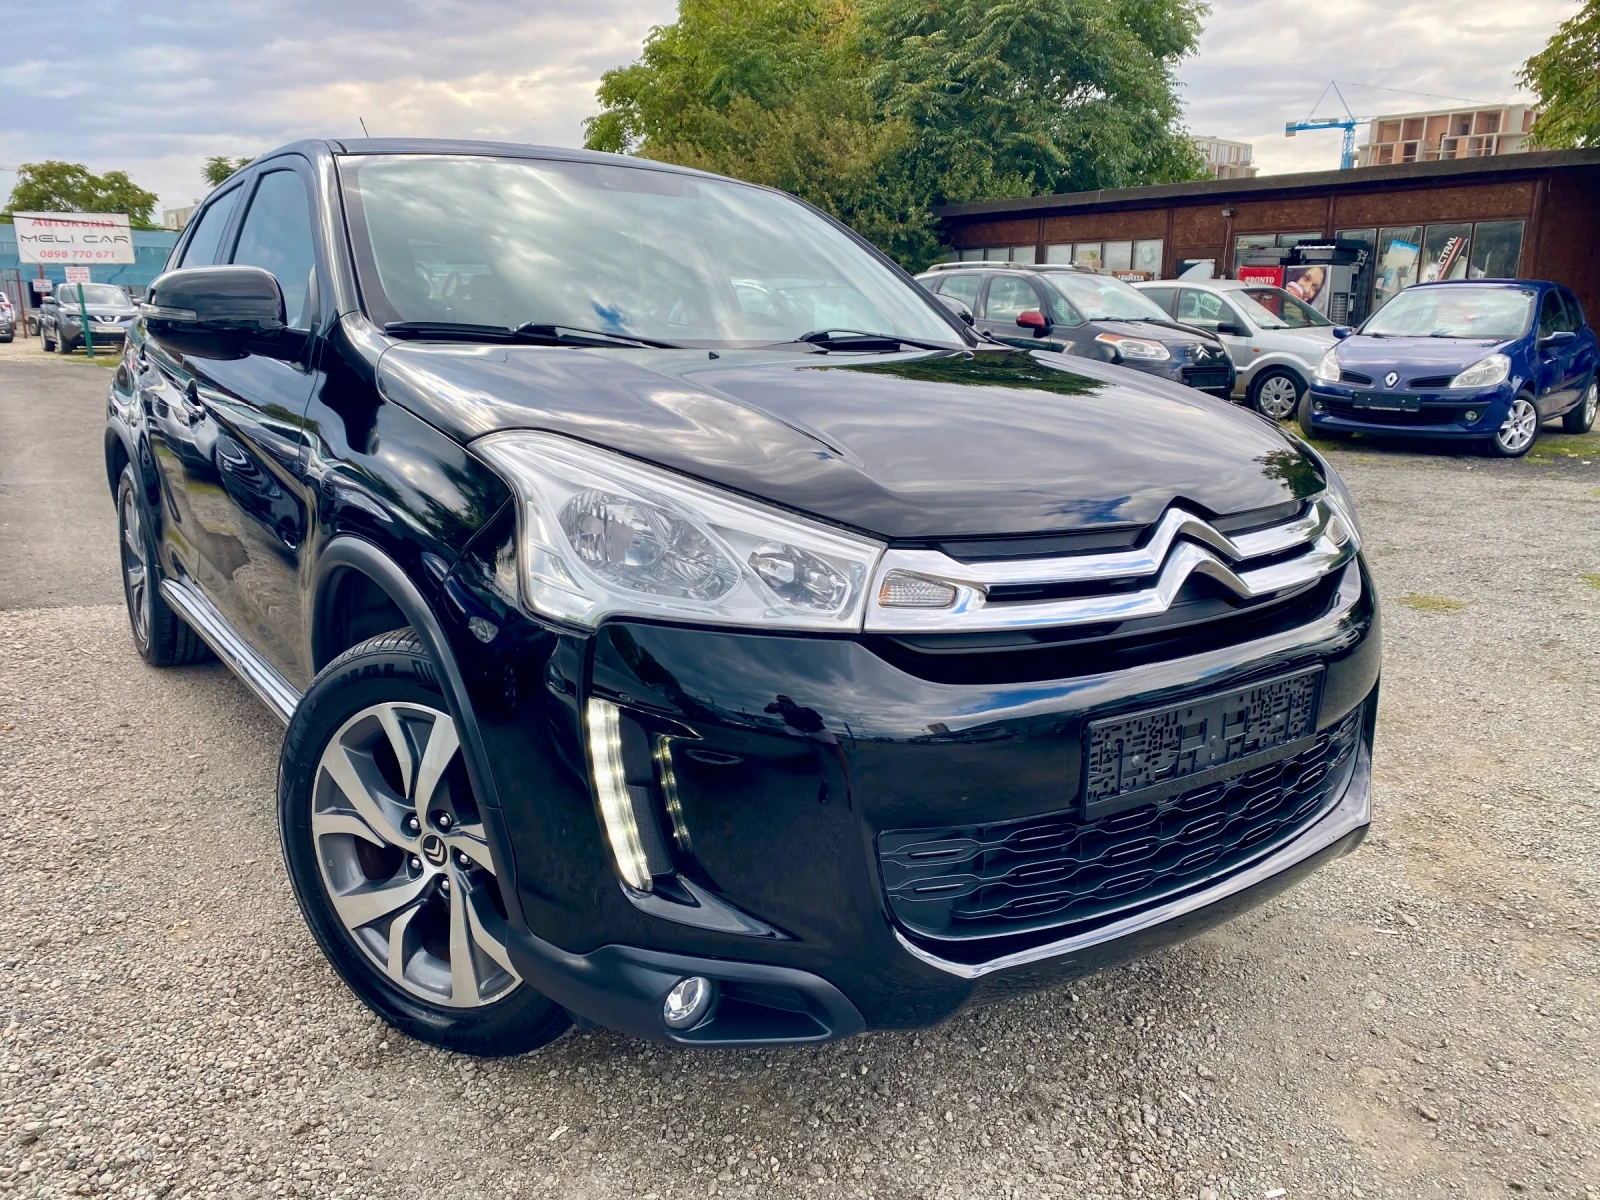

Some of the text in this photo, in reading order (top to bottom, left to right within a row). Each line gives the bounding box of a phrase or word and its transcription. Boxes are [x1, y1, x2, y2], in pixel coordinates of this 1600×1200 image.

[20, 234, 129, 243] MELI CAR
[40, 250, 115, 258] 0898 770 671
[1245, 276, 1275, 284] PRONTO
